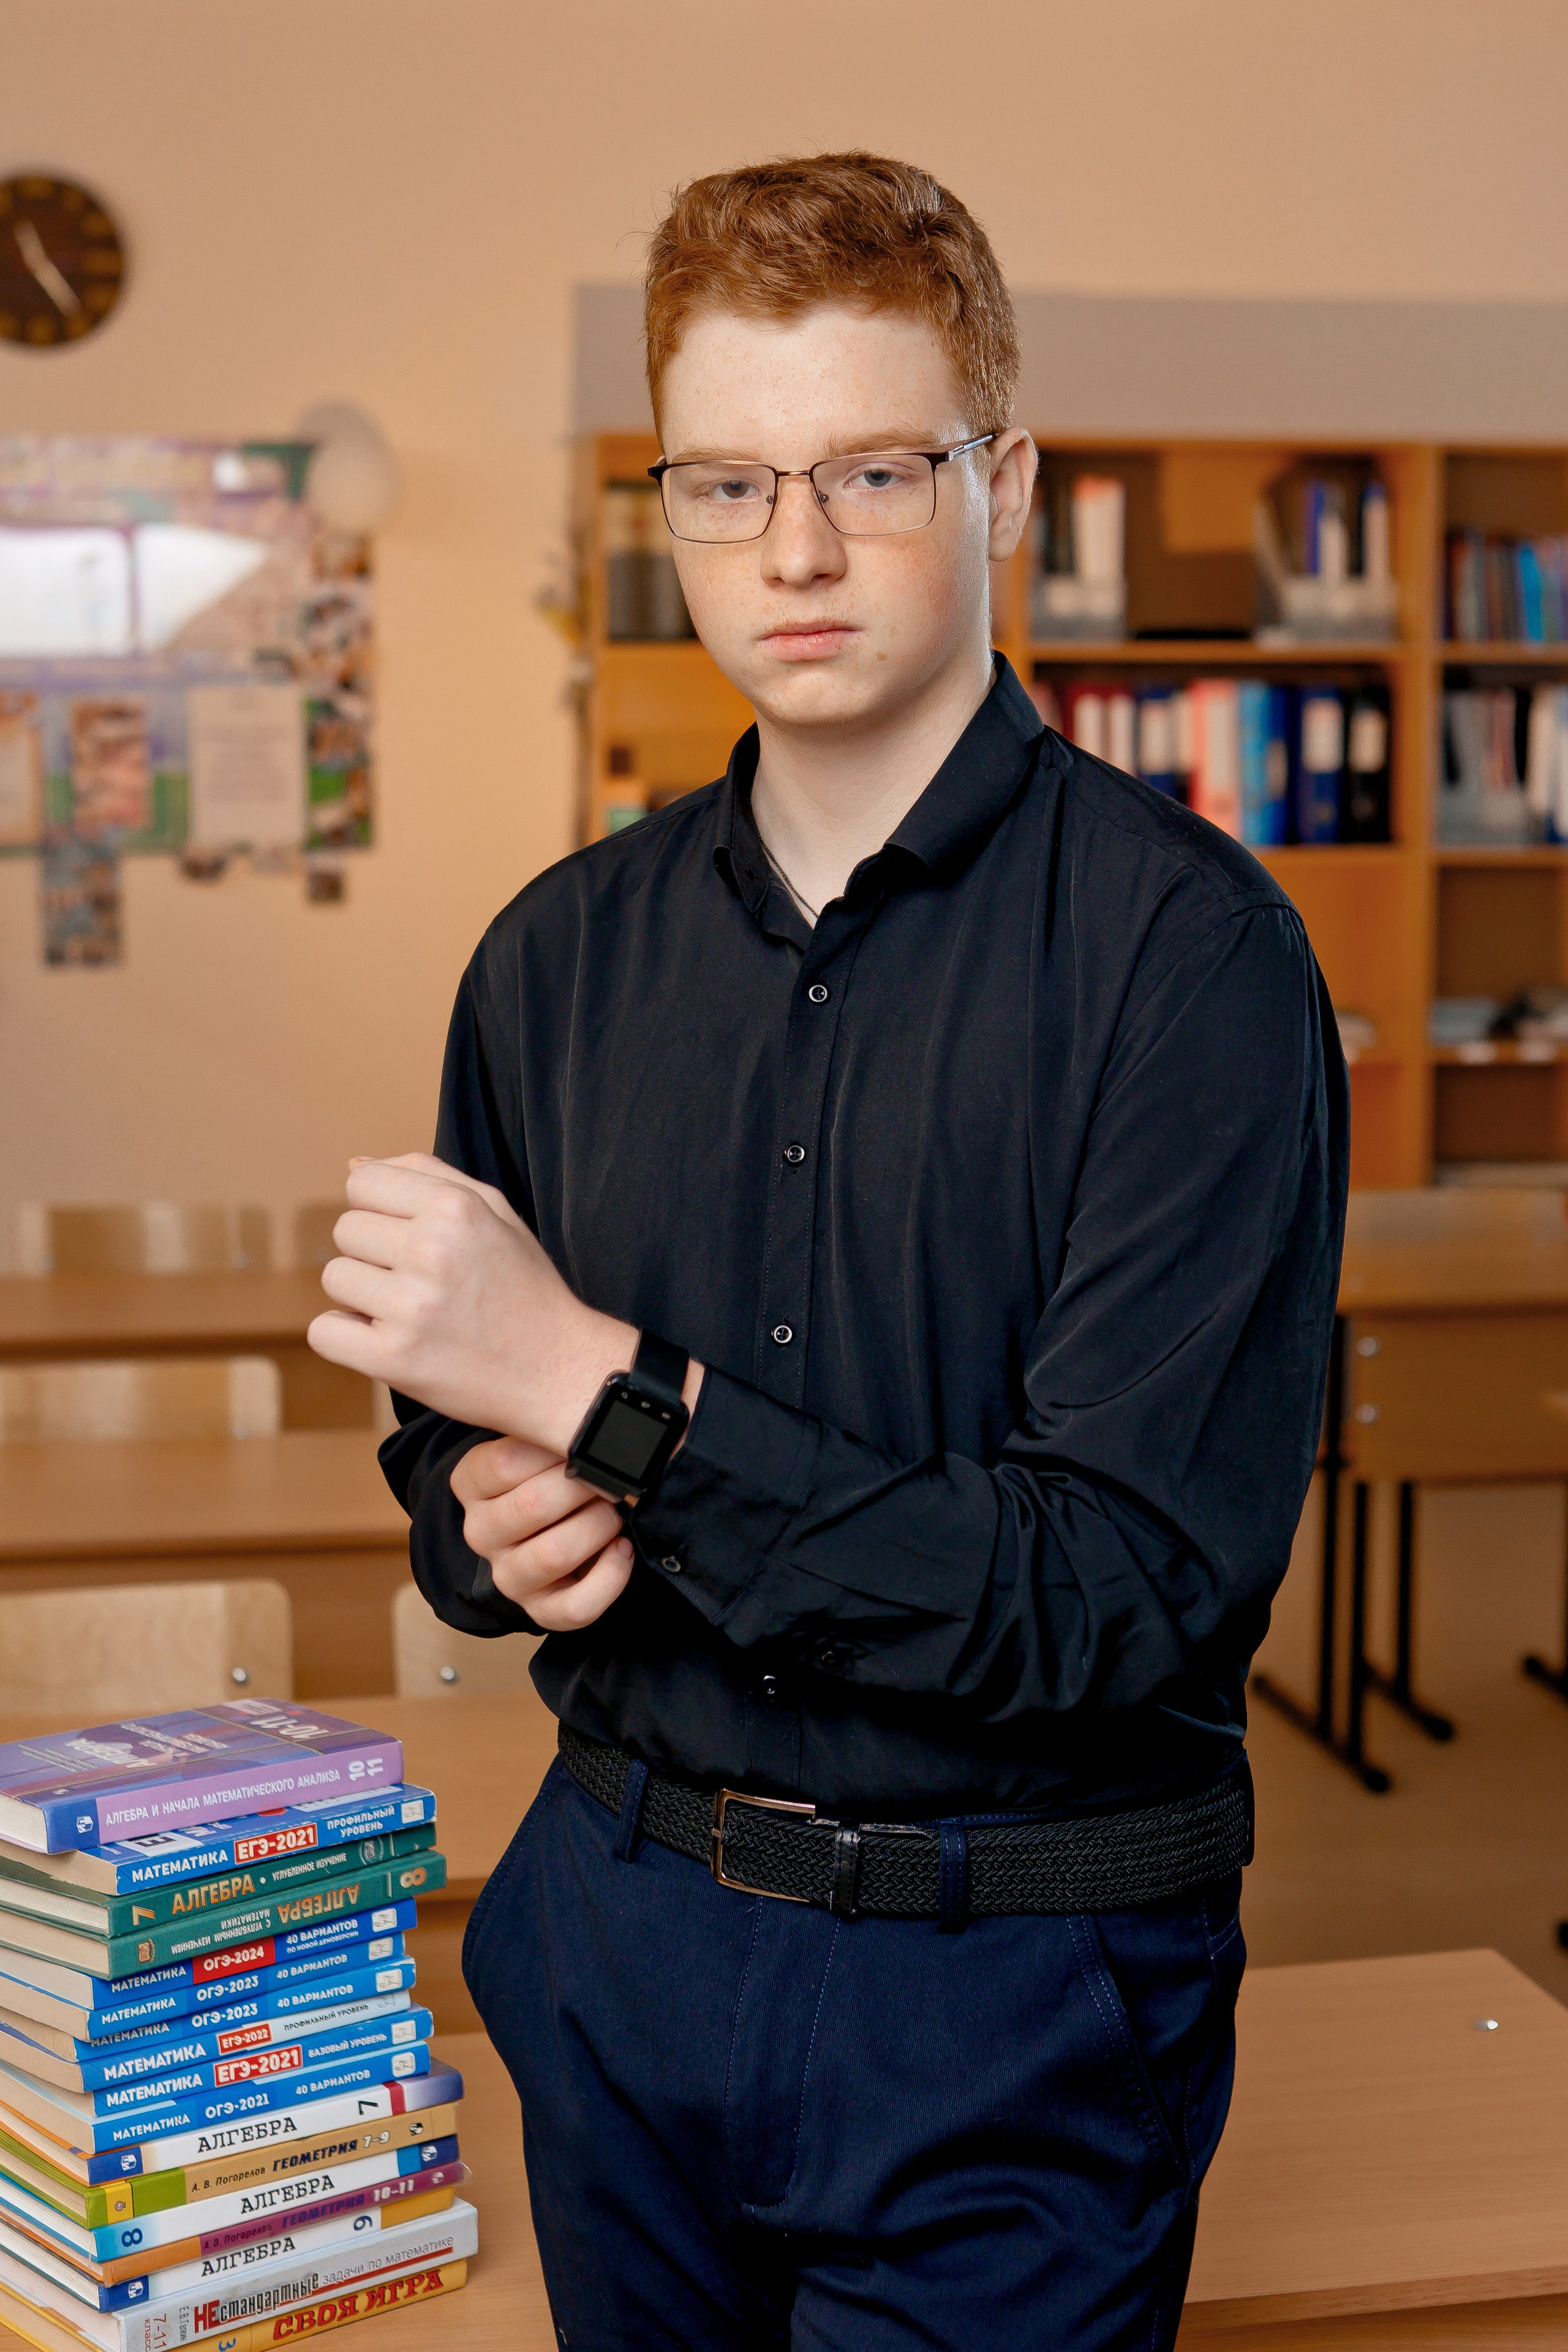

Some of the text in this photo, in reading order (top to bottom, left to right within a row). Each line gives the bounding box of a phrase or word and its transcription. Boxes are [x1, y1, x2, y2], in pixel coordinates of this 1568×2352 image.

[249, 1715, 330, 1739] 10-11
[349, 1760, 366, 1782] 10
[367, 1758, 383, 1777] 11
[106, 1806, 149, 1826] АЛГЕБРА
[152, 1803, 160, 1817] И
[162, 1796, 200, 1814] НАЧАЛА
[203, 1778, 295, 1807] МАТЕМАТИЧЕСКОГО
[298, 1770, 341, 1787] АНАЛИЗА
[327, 1805, 394, 1830] ПРОФИЛЬНЫЙ
[340, 1820, 383, 1838] УРОВЕНЬ
[132, 1828, 315, 1883] МАТЕМАТИКА ЕГЭ-2021
[399, 1868, 427, 1888] 8
[132, 1852, 347, 1926] 7 АЛГЕБРА УГЛУБЛЕННОЕ ИЗУЧЕНИЕ
[277, 1883, 360, 1924] АЛГЕБРА
[214, 1920, 263, 1943] УГЛУБЛЕННЫМ
[221, 1908, 271, 1929] МАТЕМАТИКИ
[286, 1919, 358, 1944] 40 ВАРИАНТОВ
[111, 1945, 265, 1993] МАТЕМАТИКА ОГЭ-2024
[171, 1936, 211, 1954] ИЗУЧЕНИЕМ
[297, 1940, 318, 1951] НОВОЙ
[102, 1954, 348, 2024] МАТЕМАТИКА ОГЭ-2023 40 ВАРИАНТОВ
[91, 1985, 353, 2048] МАТЕМАТИКА ОГЭ-2023 40 ВАРИАНТОВ
[104, 2004, 369, 2081] МАТЕМАТИКА ЕГЭ-2022 ПРОФИЛЬНЫЙ УРОВЕНЬ
[107, 2033, 387, 2107] МАТЕМАТИКА ЕГЭ-2021 БАЗОВЫЙ УРОВЕНЬ
[113, 2070, 371, 2141] МАТЕМАТИКА ОГЭ-2021 40 ВАРИАНТОВ
[197, 2100, 379, 2154] АЛГЕБРА 7
[192, 2183, 200, 2193] А.
[203, 2180, 213, 2189] В.
[216, 2167, 266, 2187] Погорелов
[273, 2139, 358, 2173] ГЕОМЕТРИЯ
[121, 2174, 335, 2247] 8 АЛГЕБРА
[203, 2179, 414, 2251] А. В. Погорелов ГЕОМЕТРИЯ 10-11
[201, 2237, 296, 2277] АЛГЕБРА
[194, 2235, 454, 2334] НЕстандартные задачи по математике
[273, 2294, 359, 2340] СВОЯ
[364, 2269, 443, 2313] ИГРА
[153, 2313, 167, 2350] 7-11
